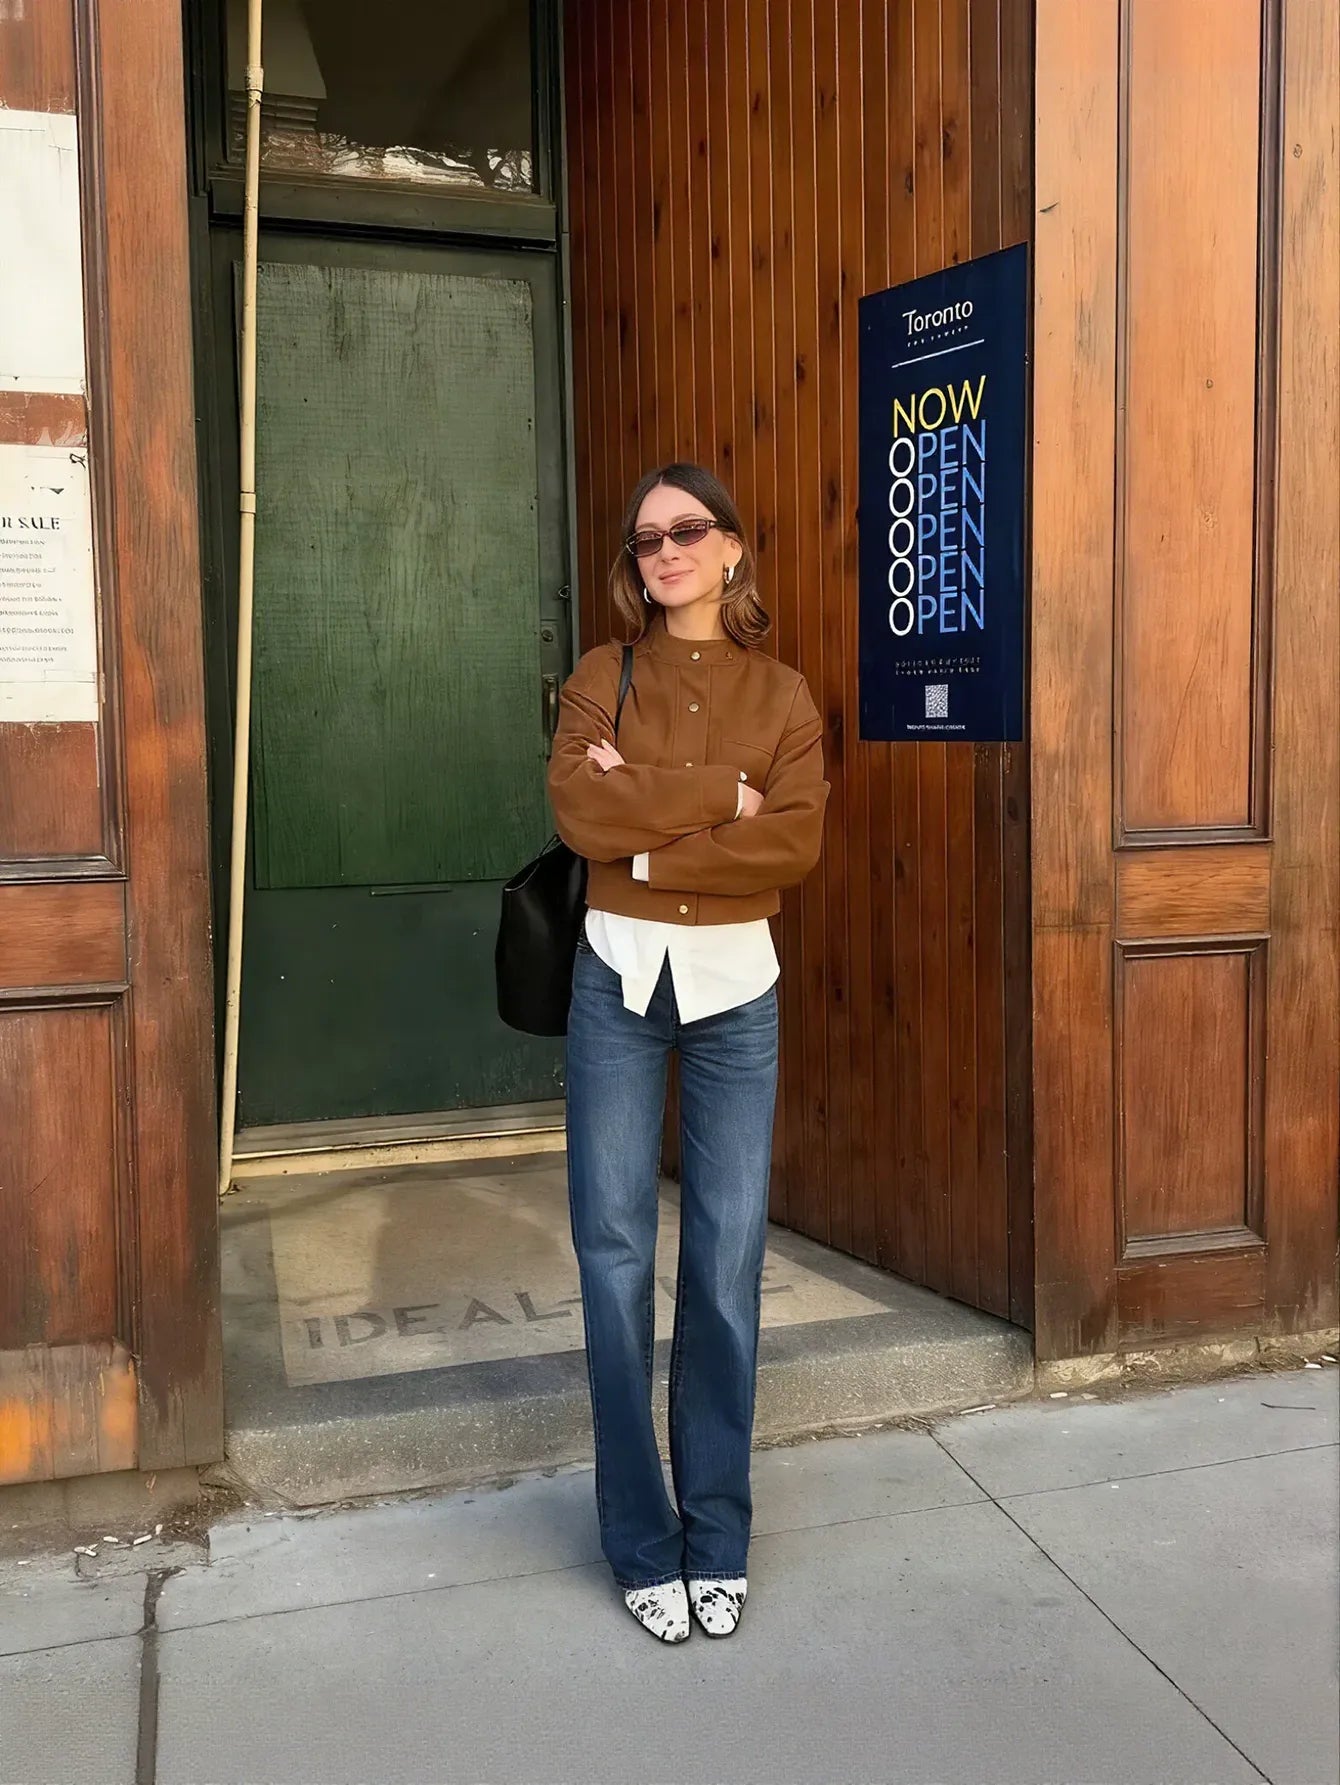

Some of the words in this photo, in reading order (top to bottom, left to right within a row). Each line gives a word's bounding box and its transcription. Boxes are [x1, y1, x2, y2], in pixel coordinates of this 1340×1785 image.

[902, 300, 974, 336] Toronto
[893, 374, 987, 438] NOW
[888, 419, 986, 478] OPEN
[888, 462, 986, 518] OPEN
[888, 504, 986, 558] OPEN
[888, 547, 986, 598] OPEN
[888, 589, 985, 637] OPEN
